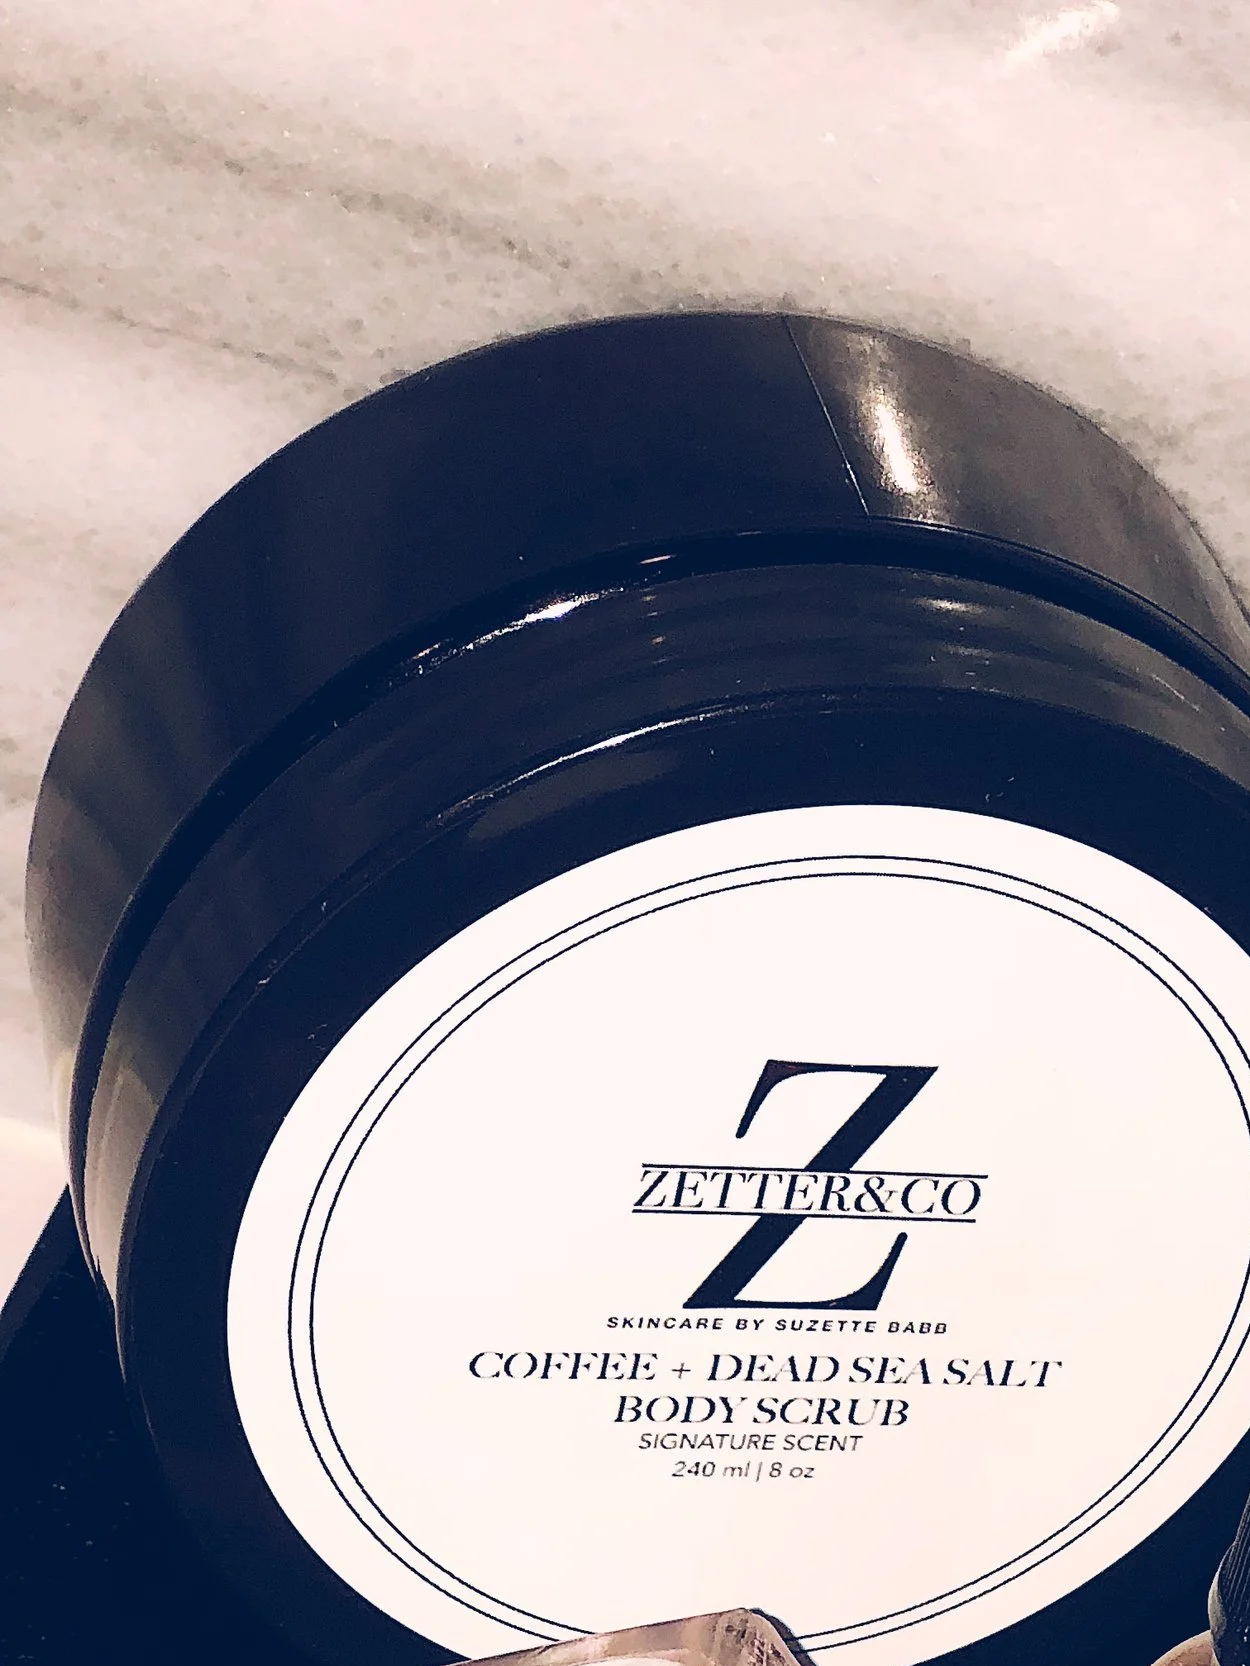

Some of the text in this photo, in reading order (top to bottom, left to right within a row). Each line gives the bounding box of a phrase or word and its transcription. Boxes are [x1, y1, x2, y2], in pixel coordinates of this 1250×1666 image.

[633, 1169, 982, 1217] ZETTER&CO
[606, 1316, 948, 1334] SKINCARE BY SUZETTE BABB
[468, 1351, 1062, 1389] COFFEE + DEAD SEA SALT
[614, 1395, 910, 1427] BODY SCRUB
[638, 1432, 863, 1452] SIGNATURE SCENT
[671, 1462, 716, 1479] 240
[722, 1462, 750, 1479] ml
[769, 1462, 782, 1479] 8
[789, 1466, 814, 1480] oz
